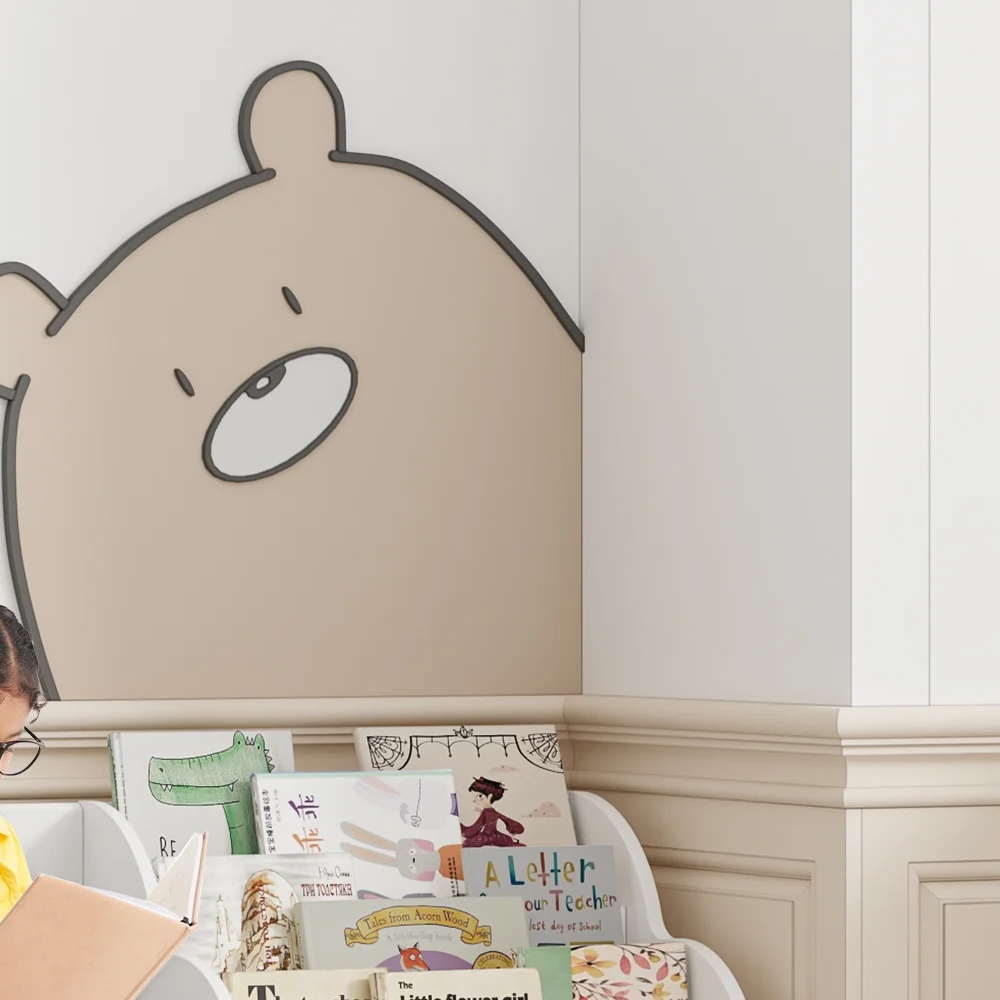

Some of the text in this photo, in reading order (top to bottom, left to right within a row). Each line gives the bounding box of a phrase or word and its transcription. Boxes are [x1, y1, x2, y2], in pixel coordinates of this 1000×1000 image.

[287, 793, 325, 854] 乖乖
[485, 860, 501, 888] A
[507, 851, 596, 887] Letter
[524, 885, 618, 912] our Teacher
[362, 909, 471, 931] Tales from Acorn Wood
[529, 918, 602, 934] last day of School
[435, 931, 453, 942] book
[398, 981, 414, 990] The
